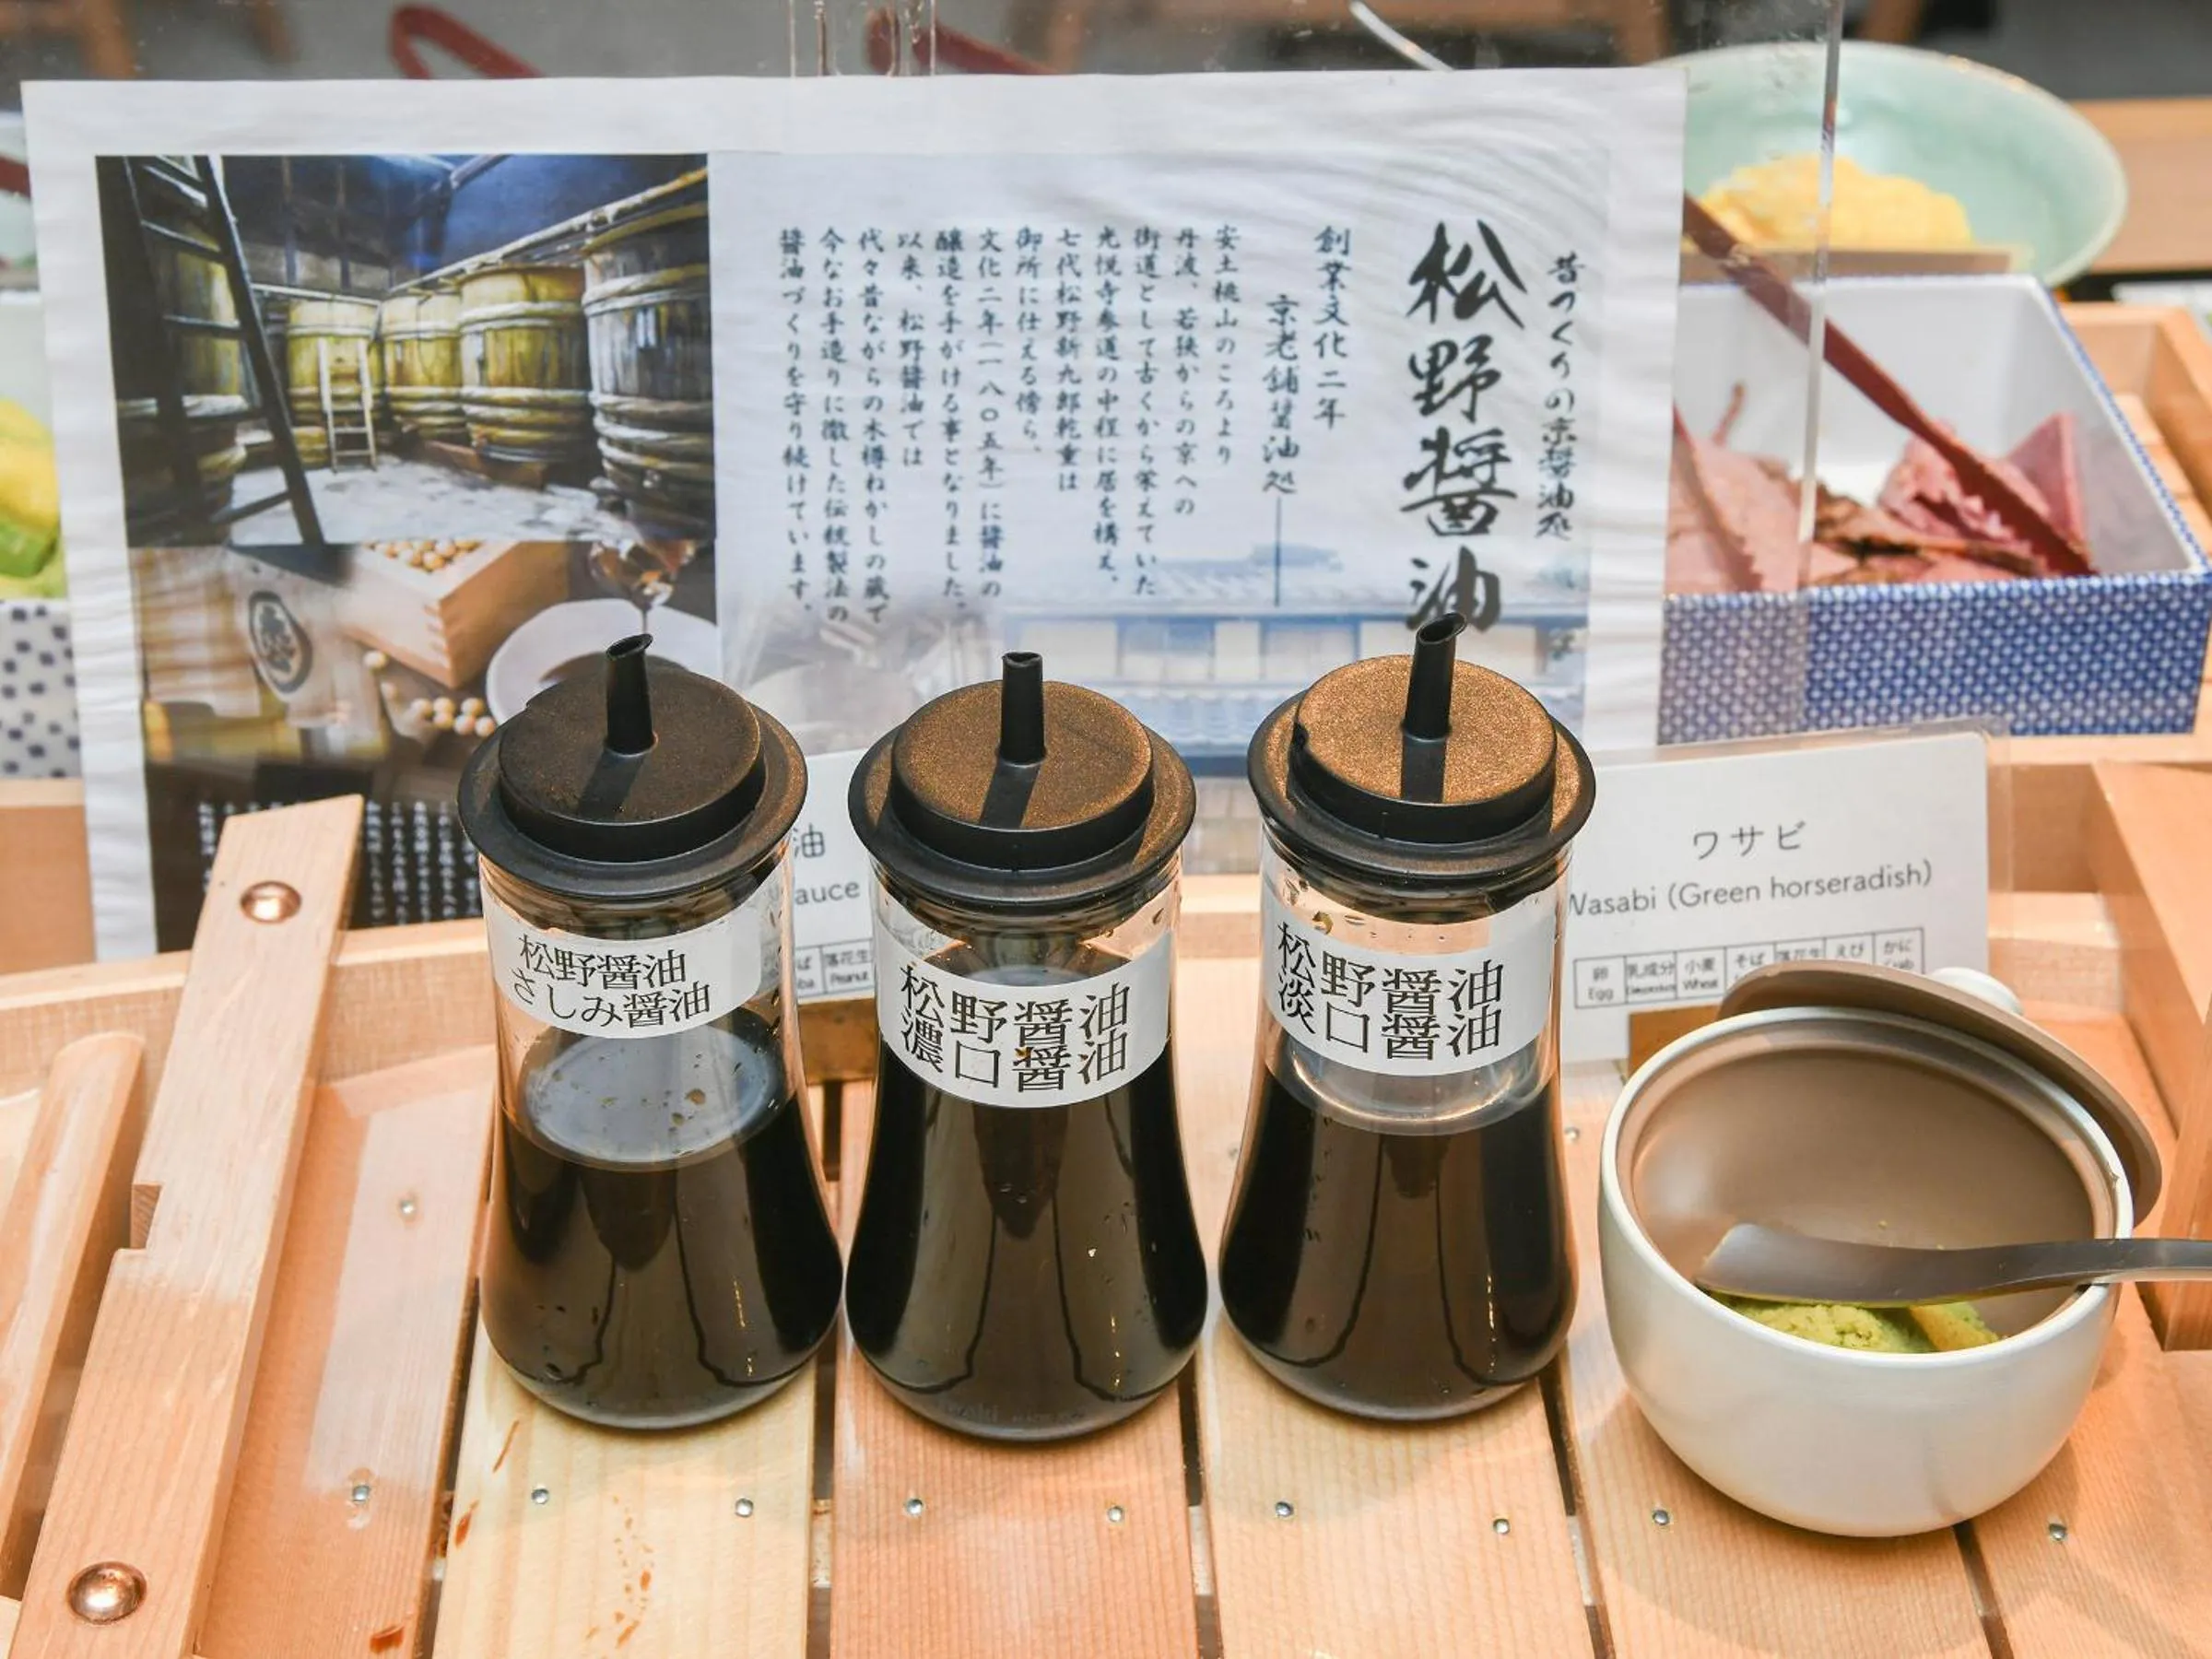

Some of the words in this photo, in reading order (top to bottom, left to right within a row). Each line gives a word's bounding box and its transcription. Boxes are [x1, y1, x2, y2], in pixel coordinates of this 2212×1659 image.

[1212, 224, 1241, 464] 安土桃山のころより
[1313, 225, 1352, 429] 創業文化二年
[794, 823, 826, 859] 油
[1692, 819, 1807, 862] ワサビ
[794, 881, 861, 906] auce
[1667, 882, 1761, 912] (Green
[1770, 858, 1934, 900] horseradish)
[509, 966, 712, 1030] さしみ醤油
[517, 933, 687, 991] 松野醤油
[1277, 921, 1504, 1017] 松野醤油
[900, 963, 1131, 1048] 松野醤油
[1277, 969, 1502, 1061] 淡口醤油
[900, 1006, 1128, 1093] 濃口醤油
